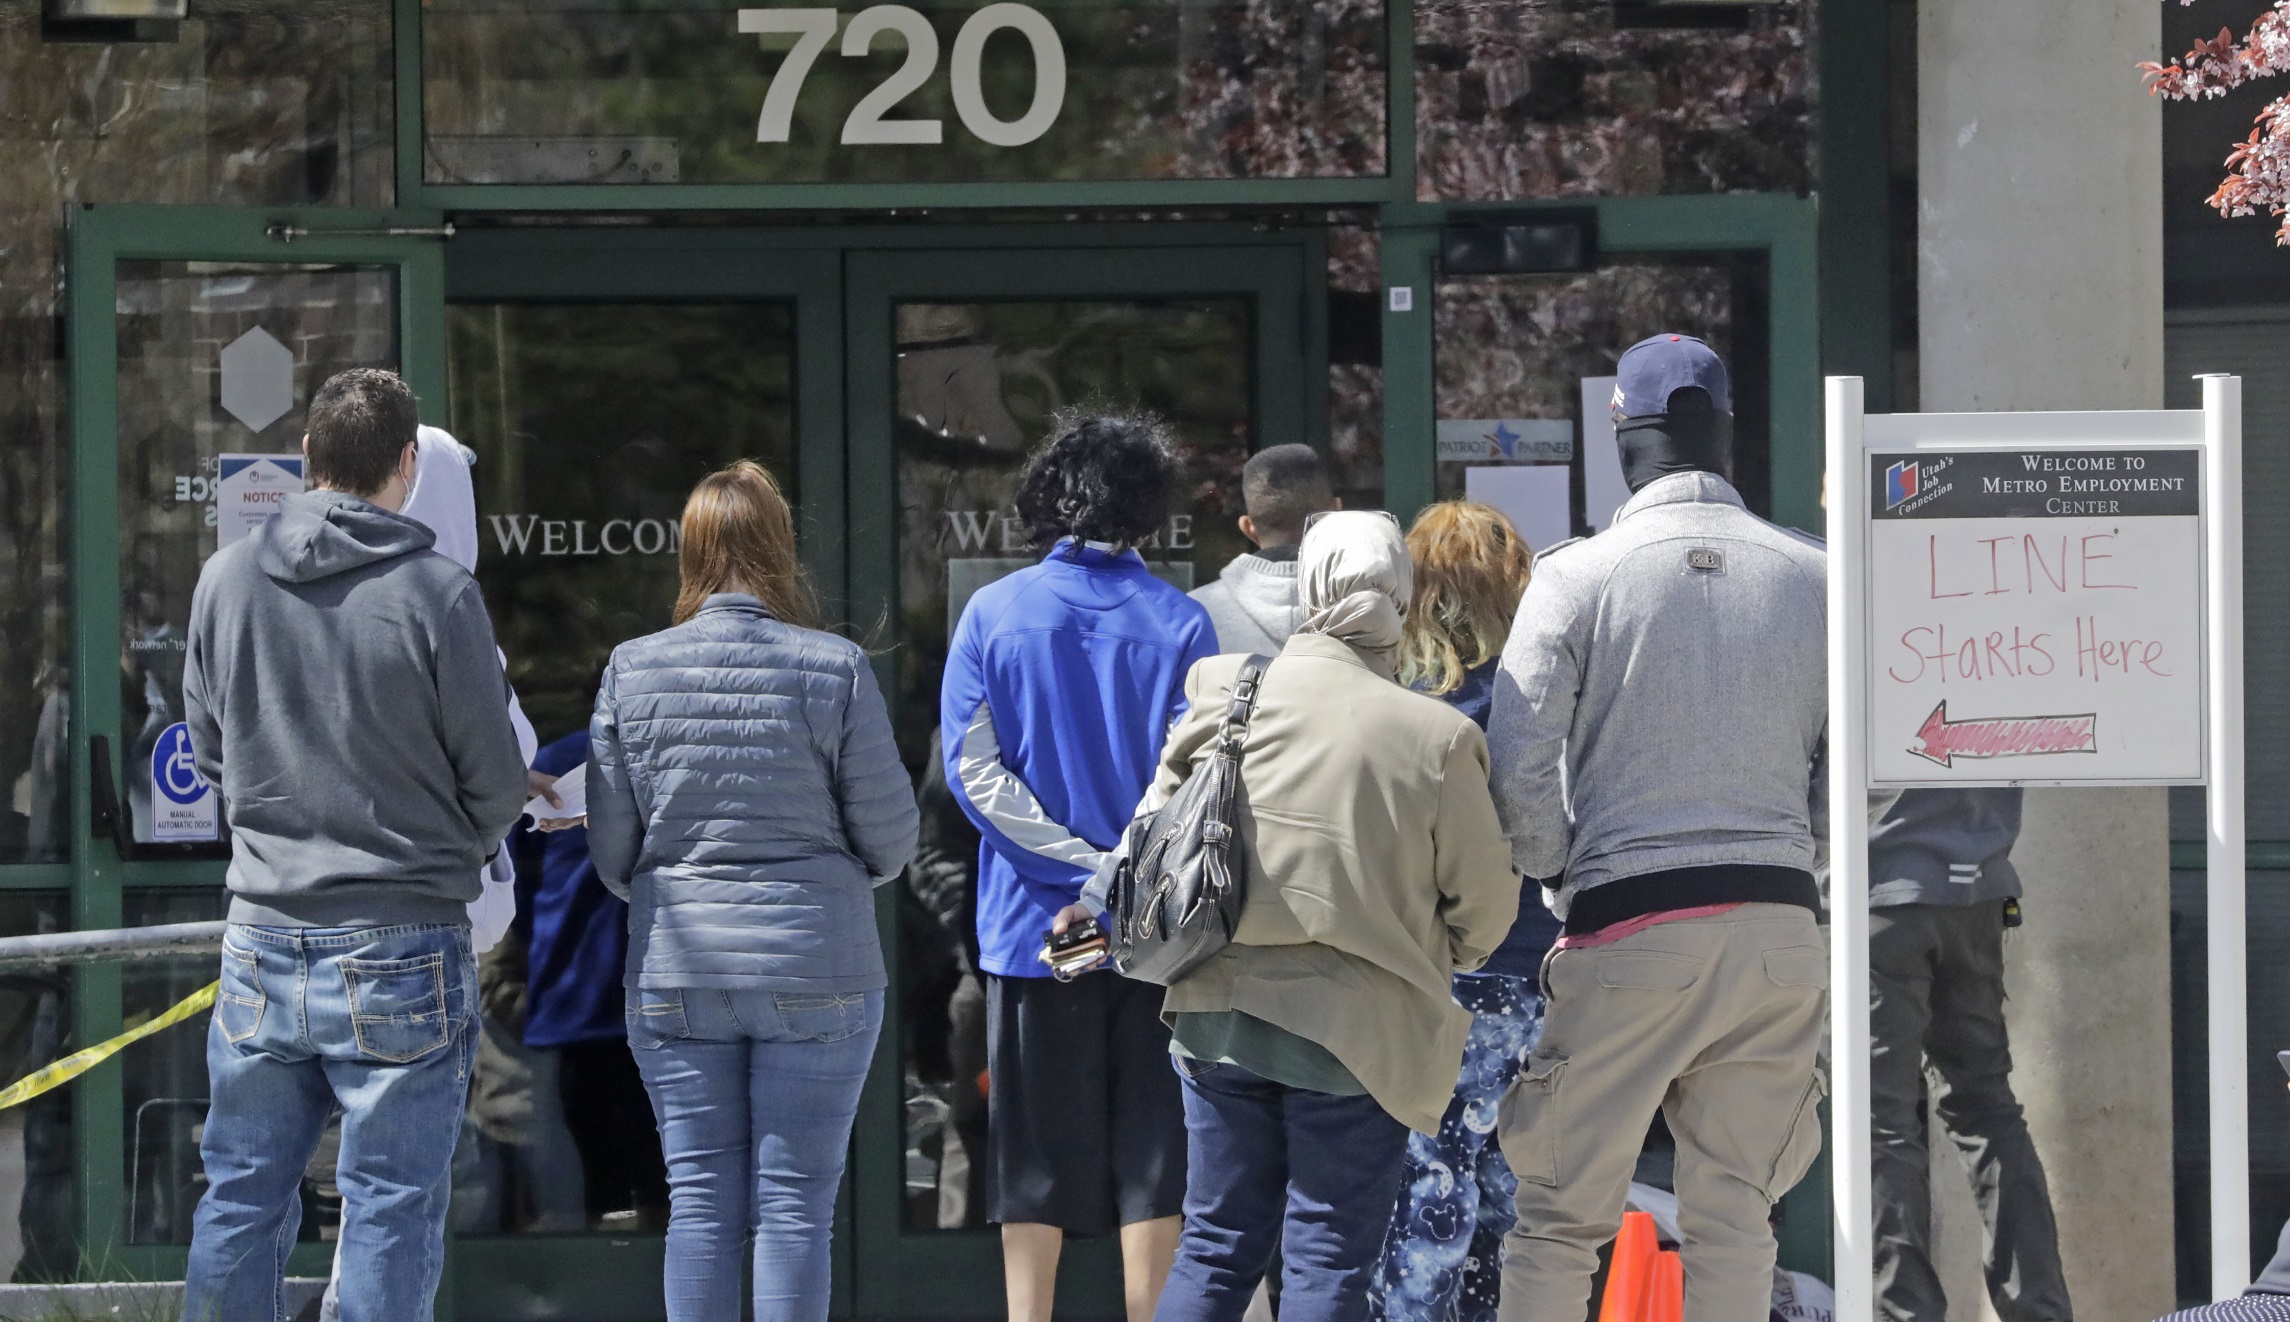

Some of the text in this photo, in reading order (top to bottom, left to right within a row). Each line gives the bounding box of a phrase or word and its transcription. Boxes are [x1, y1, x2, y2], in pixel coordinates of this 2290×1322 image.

[738, 3, 1066, 146] 720
[1438, 441, 1571, 453] PATRIOT PARTNER
[1922, 456, 1953, 478] Utah's
[2021, 455, 2146, 472] WELCOME TO
[1922, 476, 1939, 491] Job
[1982, 476, 2185, 493] METRO EMPLOYMENT
[243, 492, 284, 503] NOTIC
[1899, 483, 1953, 515] Connection
[2045, 497, 2121, 515] CENTER
[487, 513, 681, 555] WELCO
[1930, 533, 2138, 599] LINE
[2076, 616, 2172, 682] Here
[157, 821, 213, 829] AUTOMATIC DOOR
